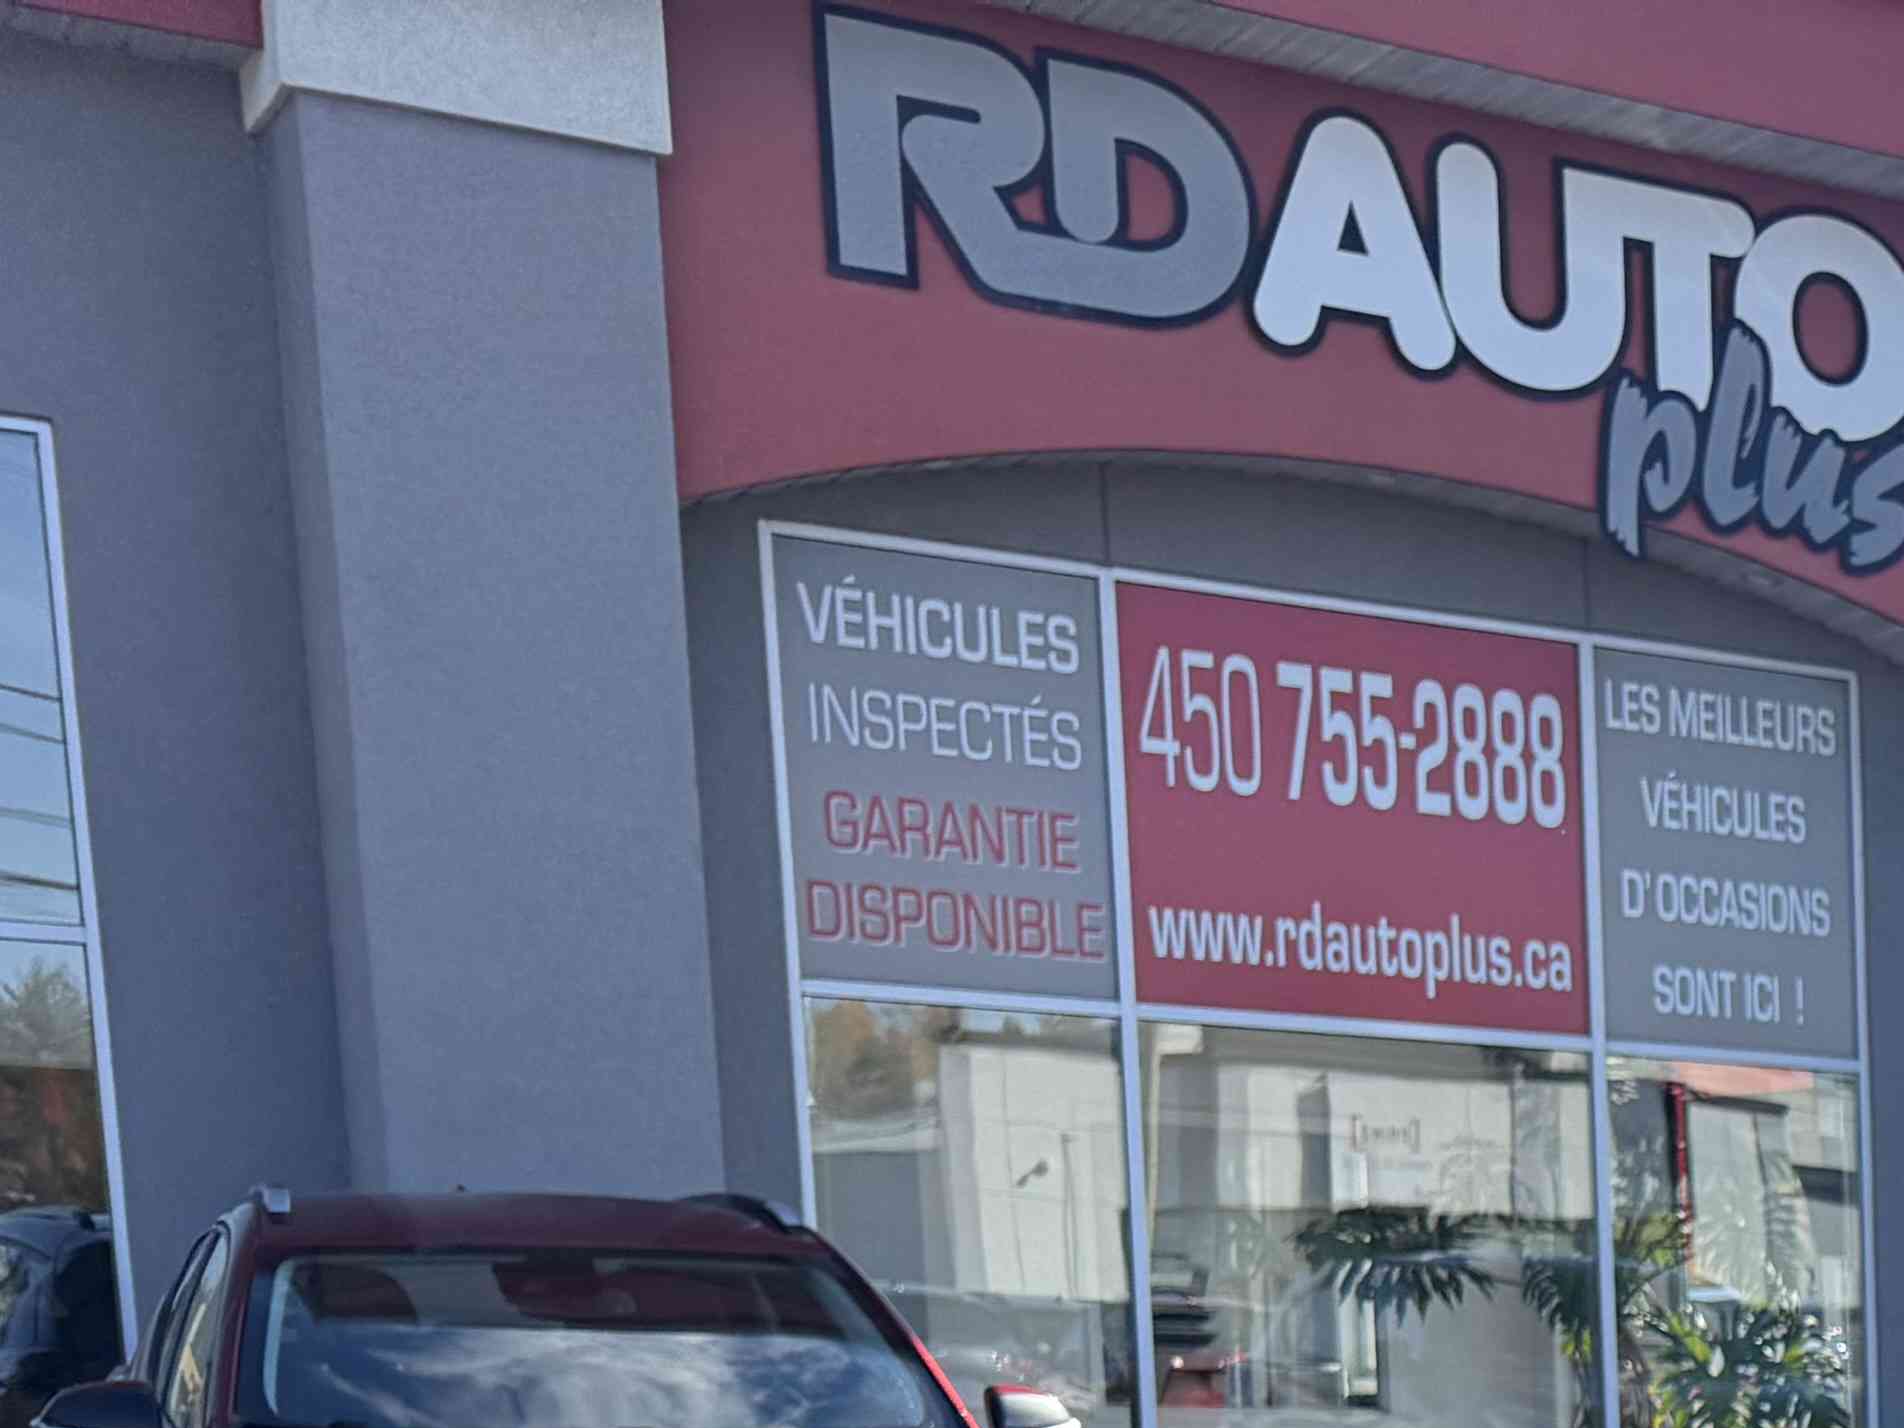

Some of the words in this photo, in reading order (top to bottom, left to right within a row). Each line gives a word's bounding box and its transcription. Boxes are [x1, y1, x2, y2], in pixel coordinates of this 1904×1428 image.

[796, 574, 1080, 675] VÉHICULES
[808, 682, 1083, 771] INSPECTÉS
[1139, 645, 1262, 797] 450
[1275, 659, 1567, 830] 755-2888
[1603, 677, 1662, 735] LES
[1667, 687, 1837, 757] MEILLEURS
[823, 789, 1082, 874] GARANTIE
[1639, 768, 1807, 844] VÉHICULES
[804, 878, 1108, 963] DISPONIBLE
[1147, 899, 1574, 1000] www.rdautoplus.ca
[1653, 963, 1737, 1020] SONT
[1744, 971, 1781, 1024] ICI
